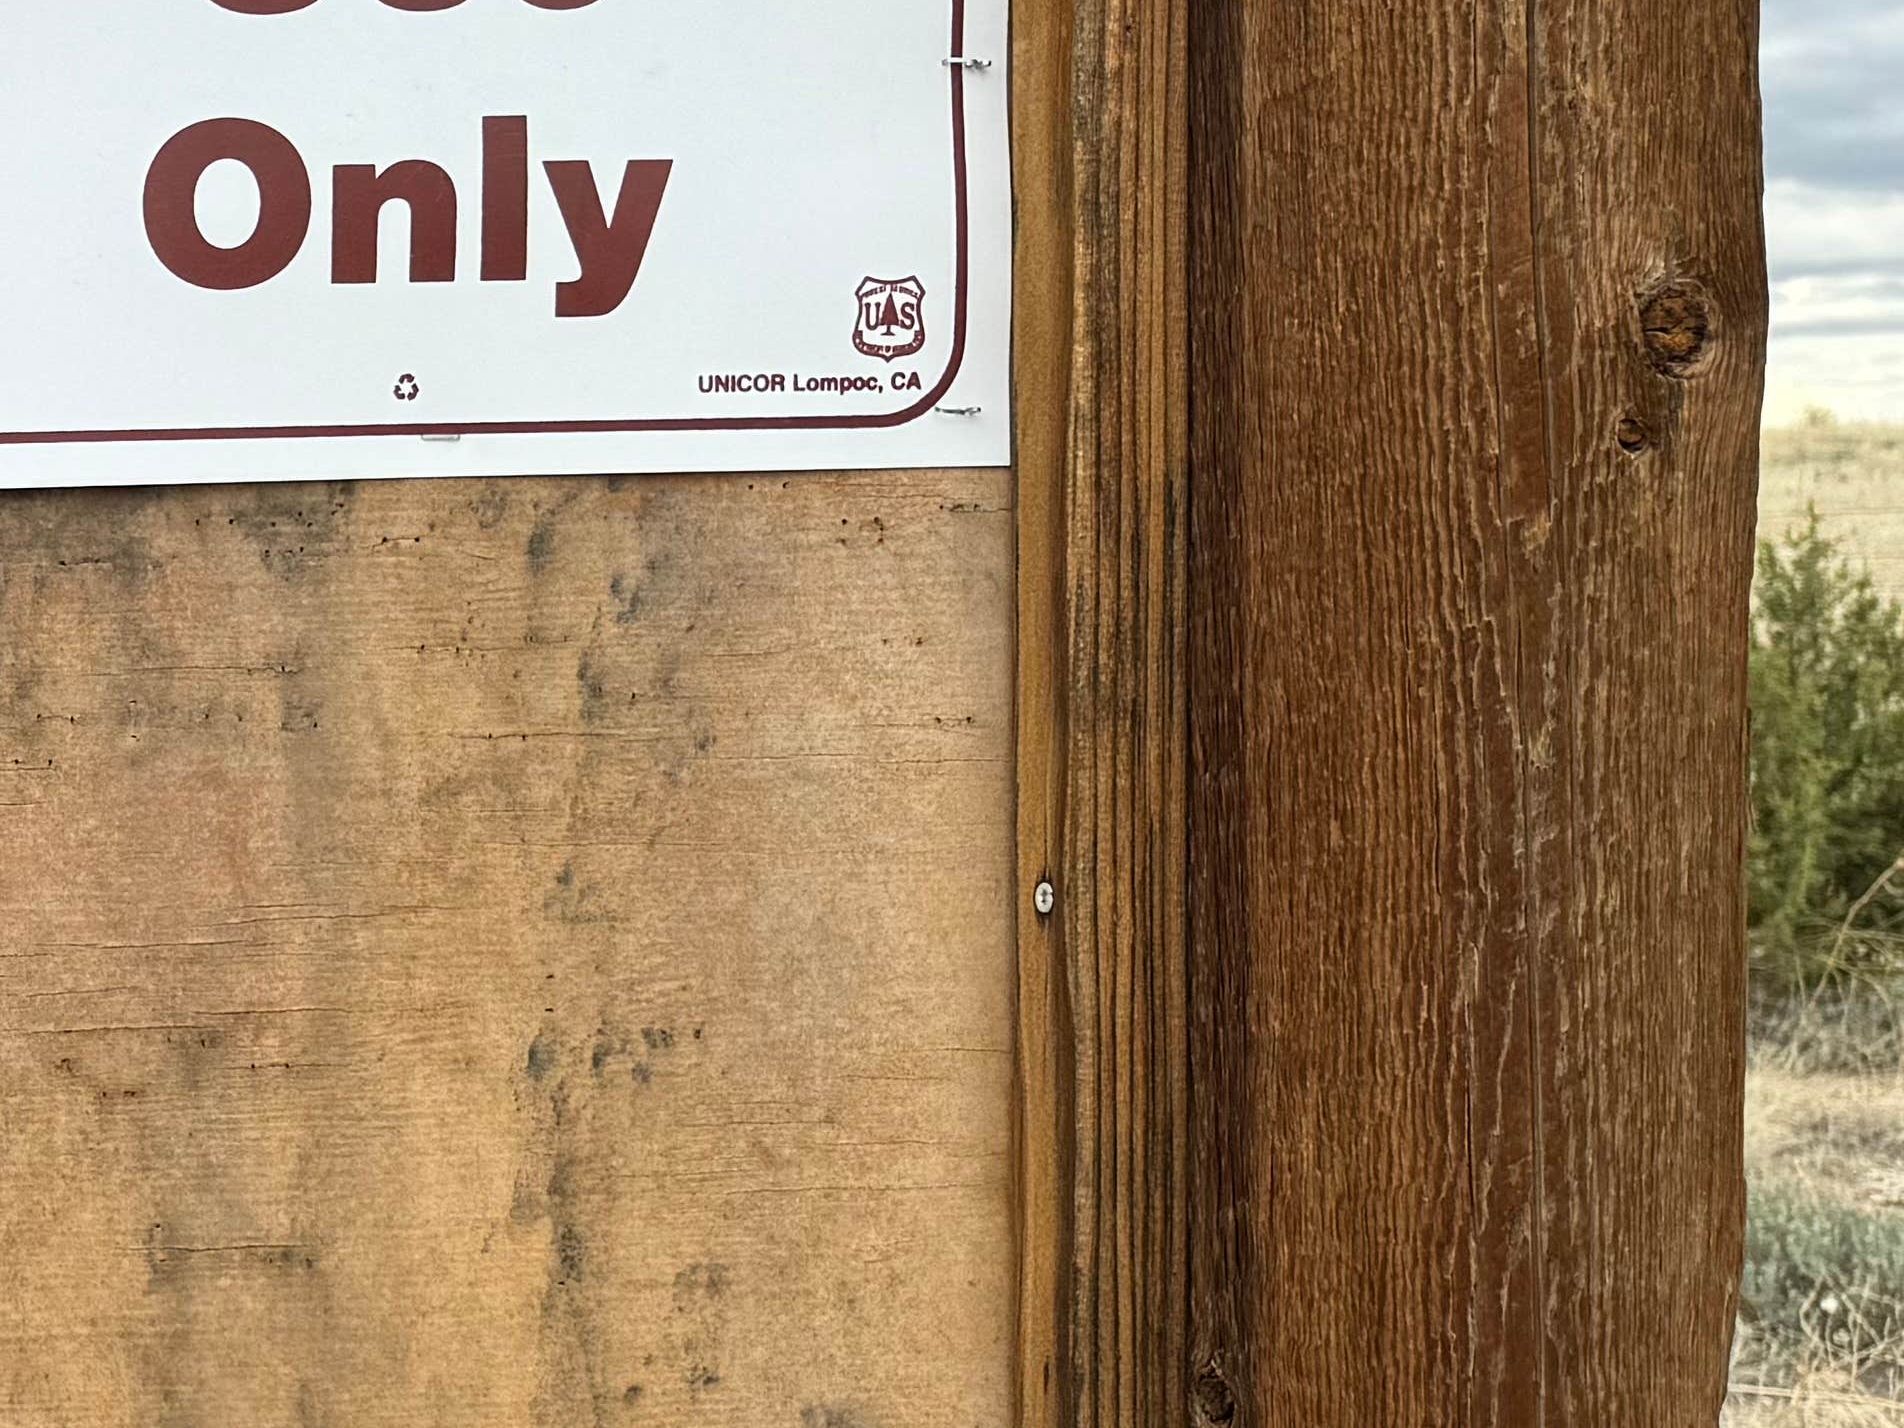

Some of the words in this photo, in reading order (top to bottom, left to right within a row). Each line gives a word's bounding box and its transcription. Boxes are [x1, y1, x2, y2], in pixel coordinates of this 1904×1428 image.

[143, 115, 673, 317] Only
[699, 373, 786, 393] UNICOR
[793, 373, 884, 395] Lompoc,
[891, 370, 922, 391] CA
